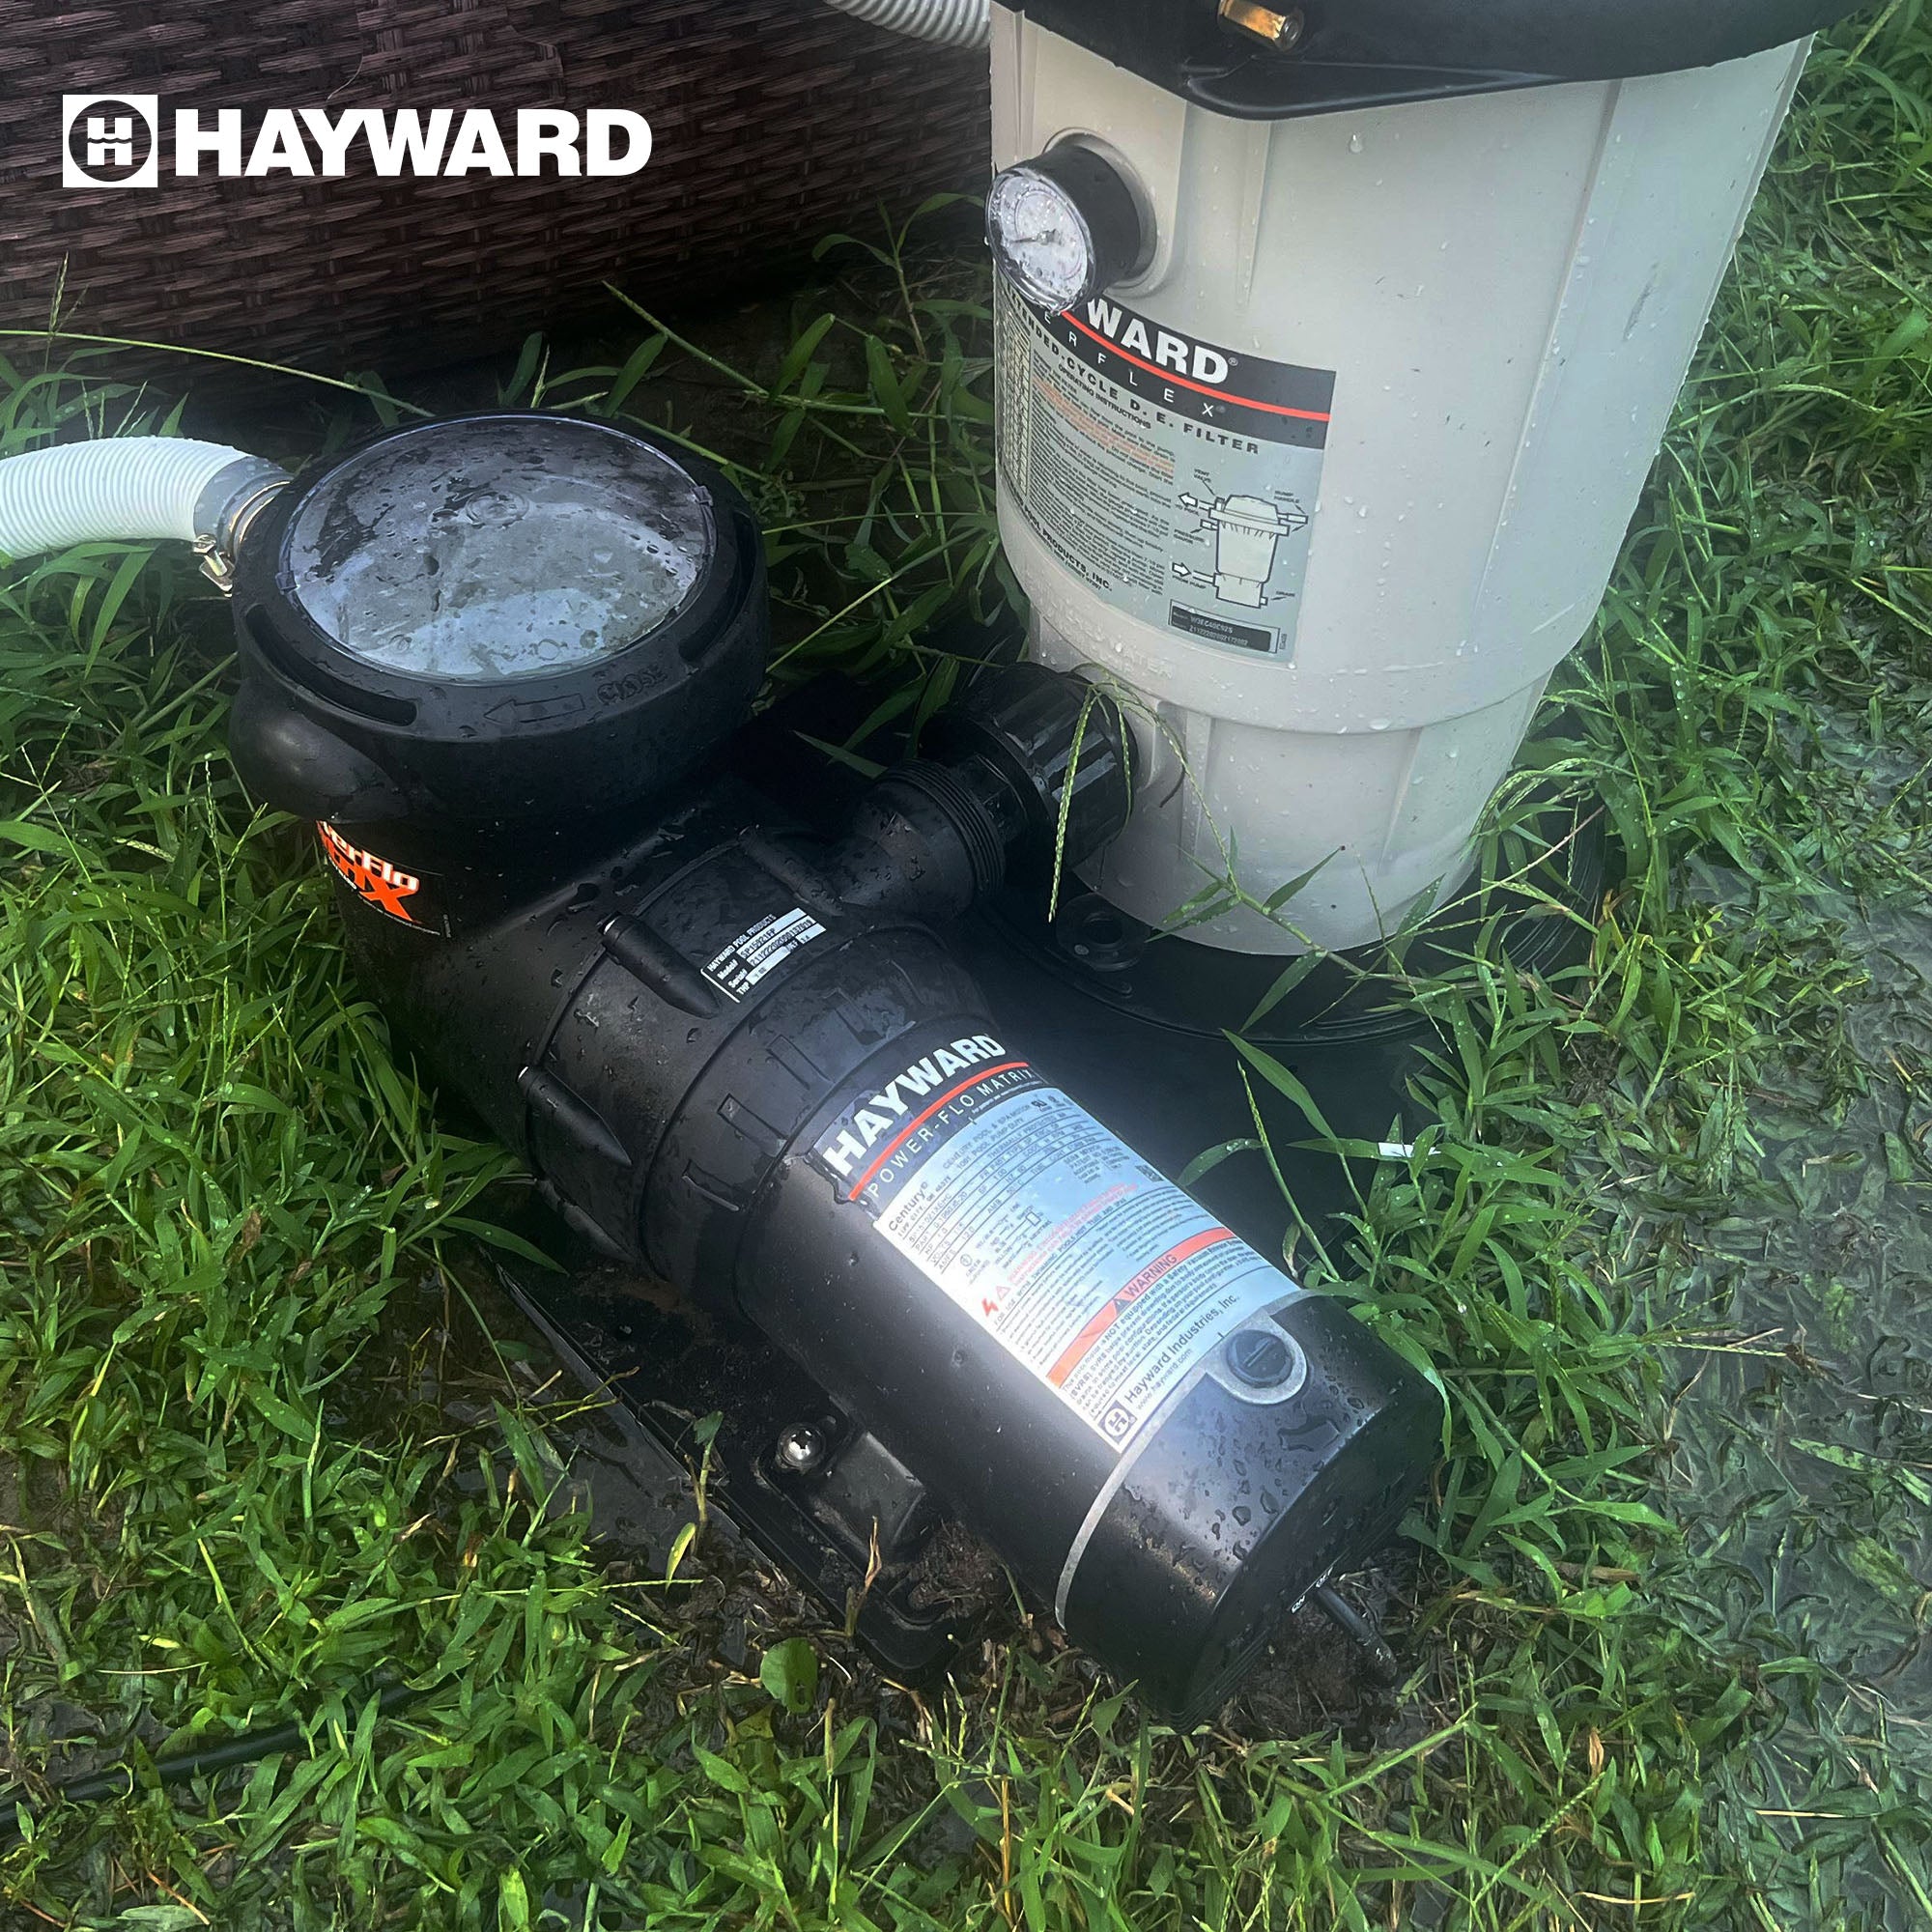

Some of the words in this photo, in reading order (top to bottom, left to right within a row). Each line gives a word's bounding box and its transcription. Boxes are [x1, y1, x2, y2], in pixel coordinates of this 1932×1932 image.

[1095, 393, 1151, 429] INSTRUCTIONS
[1183, 423, 1258, 454] FILTER
[1092, 572, 1112, 591] INC.
[707, 945, 736, 972] HAYWARD
[822, 1034, 1007, 1177] HAYWARD
[867, 1094, 975, 1198] POWER-FLO
[987, 1133, 1022, 1159] THERMALLY
[1124, 1254, 1178, 1298] WARNING
[1105, 1322, 1121, 1341] NOT
[1121, 1294, 1151, 1325] equipped
[1149, 1281, 1164, 1295] with
[1167, 1264, 1188, 1280] Safety
[1123, 1352, 1171, 1404] Hayward
[1168, 1304, 1224, 1353] Industries,
[1218, 1293, 1240, 1309] Inc.
